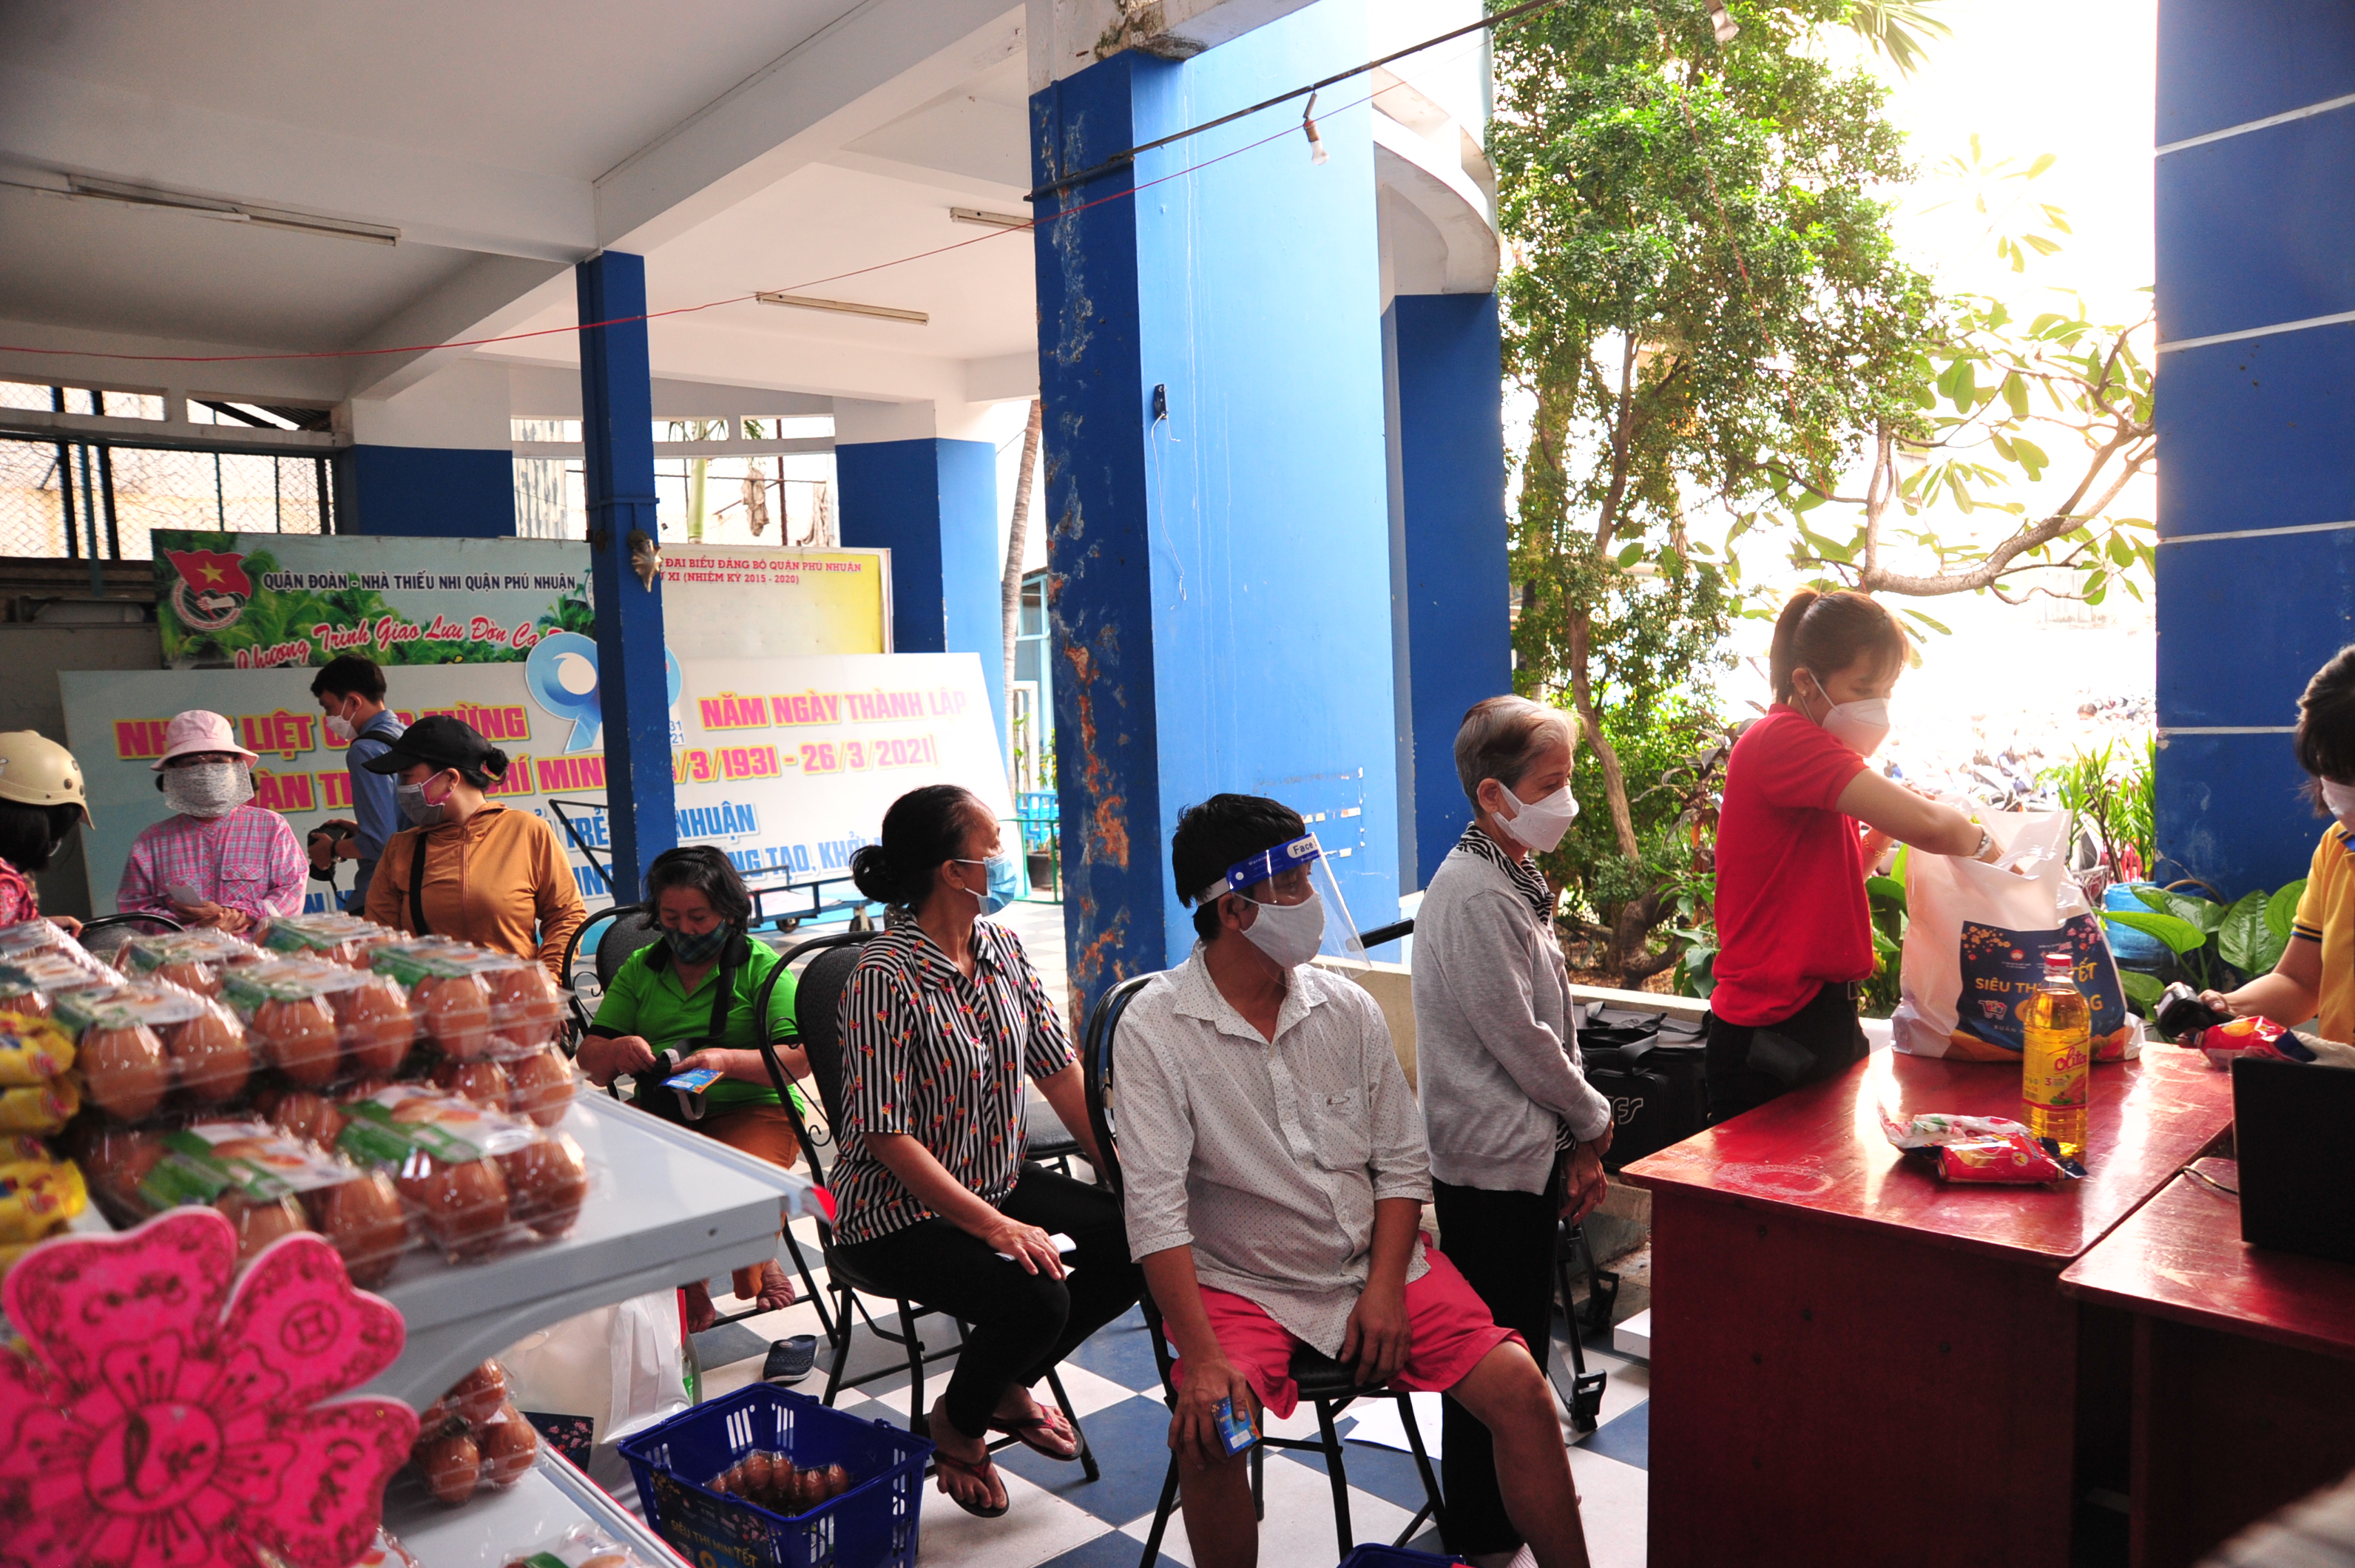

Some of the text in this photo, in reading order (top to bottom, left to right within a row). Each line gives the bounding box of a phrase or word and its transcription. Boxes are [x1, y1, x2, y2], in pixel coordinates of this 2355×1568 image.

[665, 558, 686, 569] ĐẠI
[689, 555, 714, 569] BIỂU
[718, 558, 750, 570] ĐẢNG
[753, 558, 767, 570] BỘ
[769, 560, 800, 571] QUẬN
[802, 560, 822, 571] PHÚ
[825, 561, 861, 573] NHUẬN
[263, 570, 304, 592] QUẬN
[308, 570, 348, 589] ĐOÀN
[361, 572, 390, 589] NHÀ
[393, 570, 434, 589] THIẾU
[439, 575, 462, 589] NHI
[465, 572, 500, 592] QUẬN
[504, 572, 530, 589] PHÚ
[534, 573, 575, 592] NHUẬN
[668, 572, 680, 581] XI
[683, 570, 724, 583] (NHIỆM
[745, 574, 766, 583] 2015
[774, 575, 799, 584] 2020)
[313, 620, 369, 651] Trình
[376, 616, 419, 650] Giao
[425, 615, 464, 640] Lưu
[512, 622, 538, 648] Ca
[242, 710, 312, 757] LIỆT
[700, 694, 768, 728] NĂM
[771, 690, 839, 724] NGÀY
[845, 688, 925, 720] THÀNH
[928, 687, 967, 720] LẬP
[669, 720, 682, 731] 31
[670, 733, 684, 744] 21
[537, 757, 607, 791] MIN
[675, 801, 757, 840] NHUẬN
[1292, 842, 1314, 855] Face
[727, 848, 763, 878] NG
[1975, 976, 2037, 993] SIÊU TH
[670, 1519, 691, 1539] SIÊU
